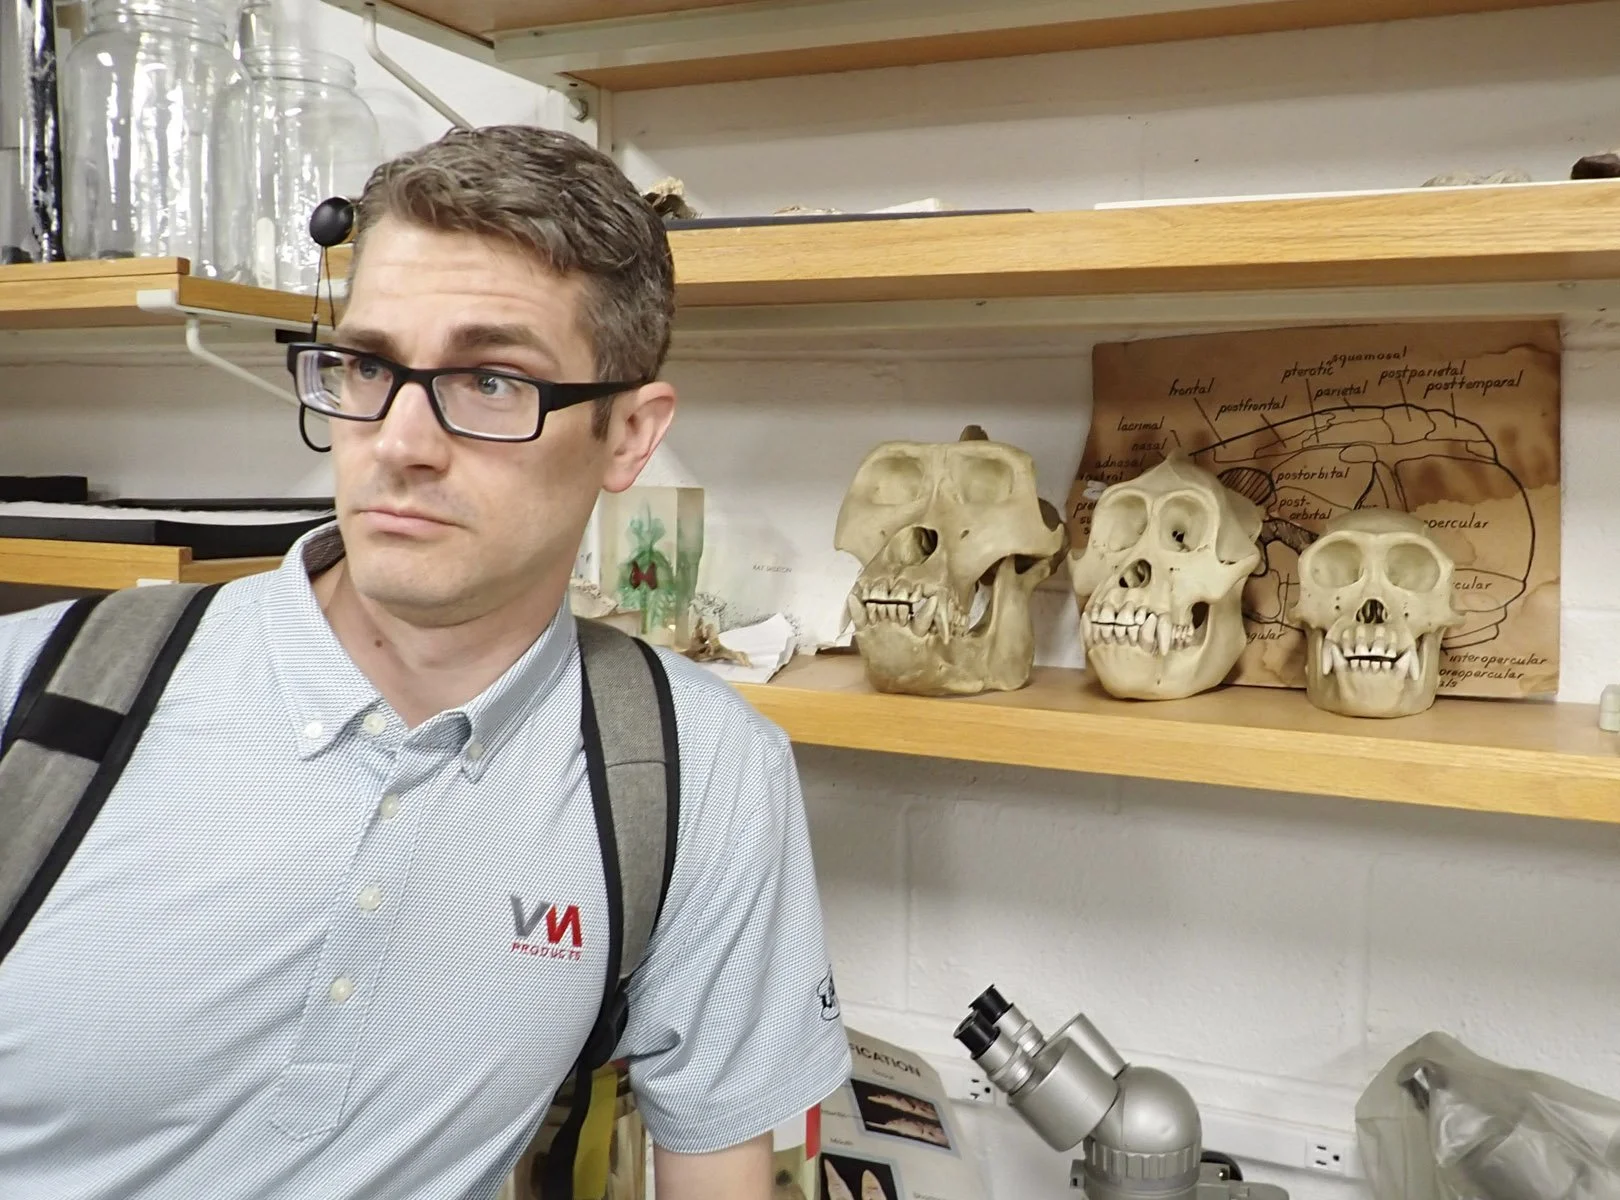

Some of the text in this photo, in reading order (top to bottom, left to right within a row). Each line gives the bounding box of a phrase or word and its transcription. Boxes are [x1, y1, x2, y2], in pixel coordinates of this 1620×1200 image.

[1332, 345, 1407, 368] squamosal
[1281, 361, 1334, 384] pterotic
[1378, 360, 1466, 386] postparietal
[1168, 377, 1215, 397] frontal
[1313, 379, 1368, 400] parietal
[1215, 395, 1288, 421] postfrontal
[1117, 416, 1165, 432] lacrimal
[1131, 437, 1168, 451] nasal
[1275, 467, 1351, 484] postorbital
[1289, 508, 1333, 521] orbital
[1449, 652, 1548, 669] interopercular
[510, 942, 582, 961] PRODUCTS
